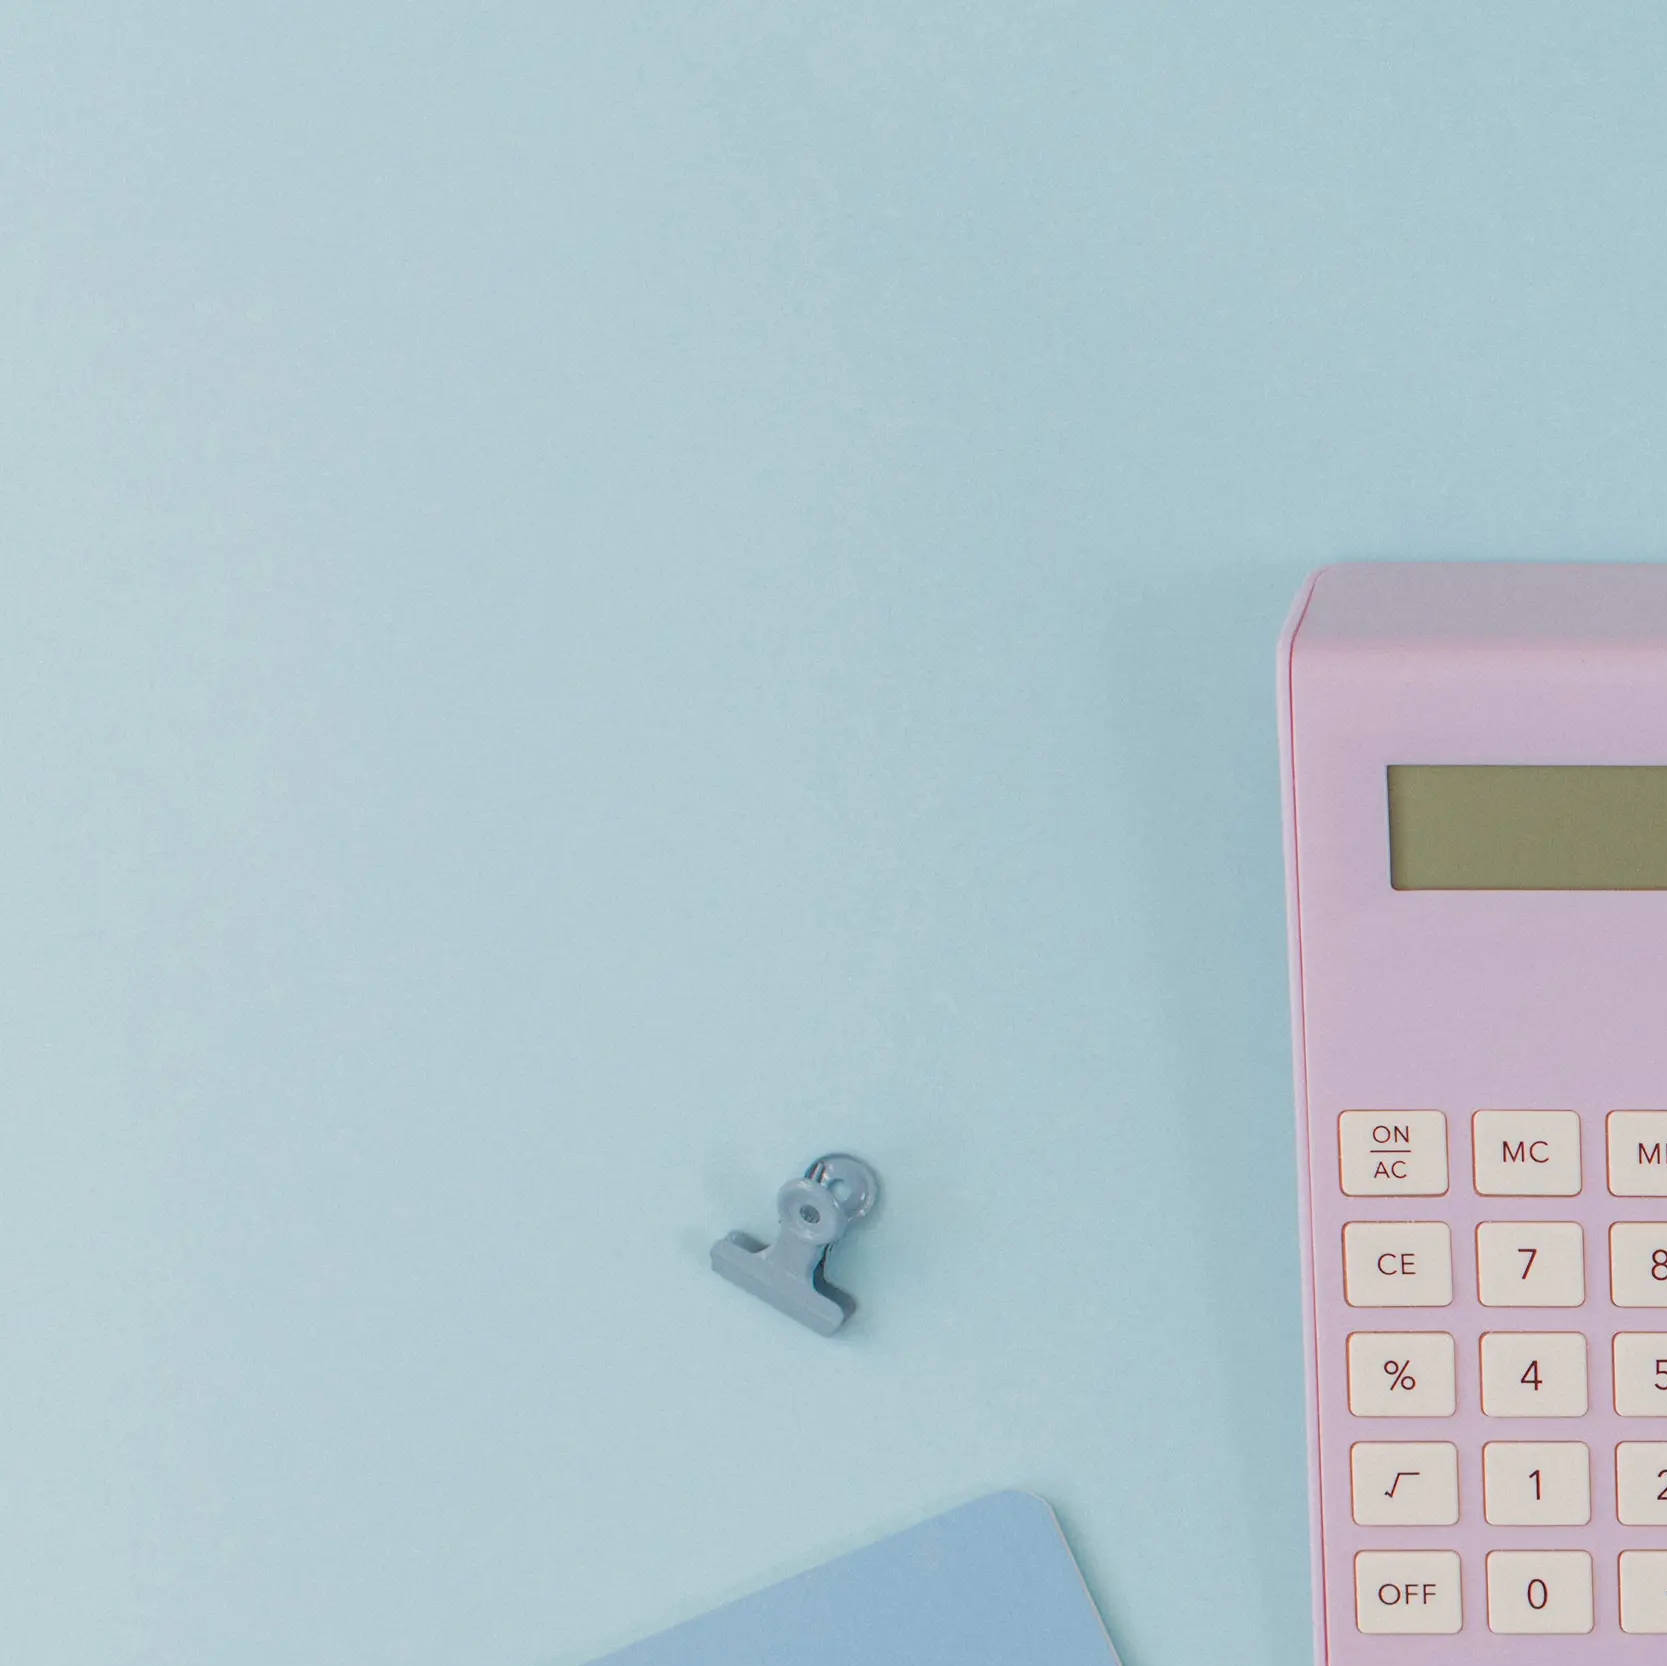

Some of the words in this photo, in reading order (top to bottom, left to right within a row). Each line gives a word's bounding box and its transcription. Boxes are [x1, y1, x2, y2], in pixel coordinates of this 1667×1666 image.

[1372, 1124, 1410, 1144] ON
[1502, 1140, 1550, 1164] MC
[1373, 1160, 1408, 1180] AC
[1377, 1252, 1417, 1276] CE
[1517, 1248, 1538, 1280] 7
[1519, 1359, 1543, 1392] 4
[1528, 1469, 1541, 1501] 1
[1377, 1583, 1437, 1606] OFF
[1526, 1578, 1549, 1610] 0
